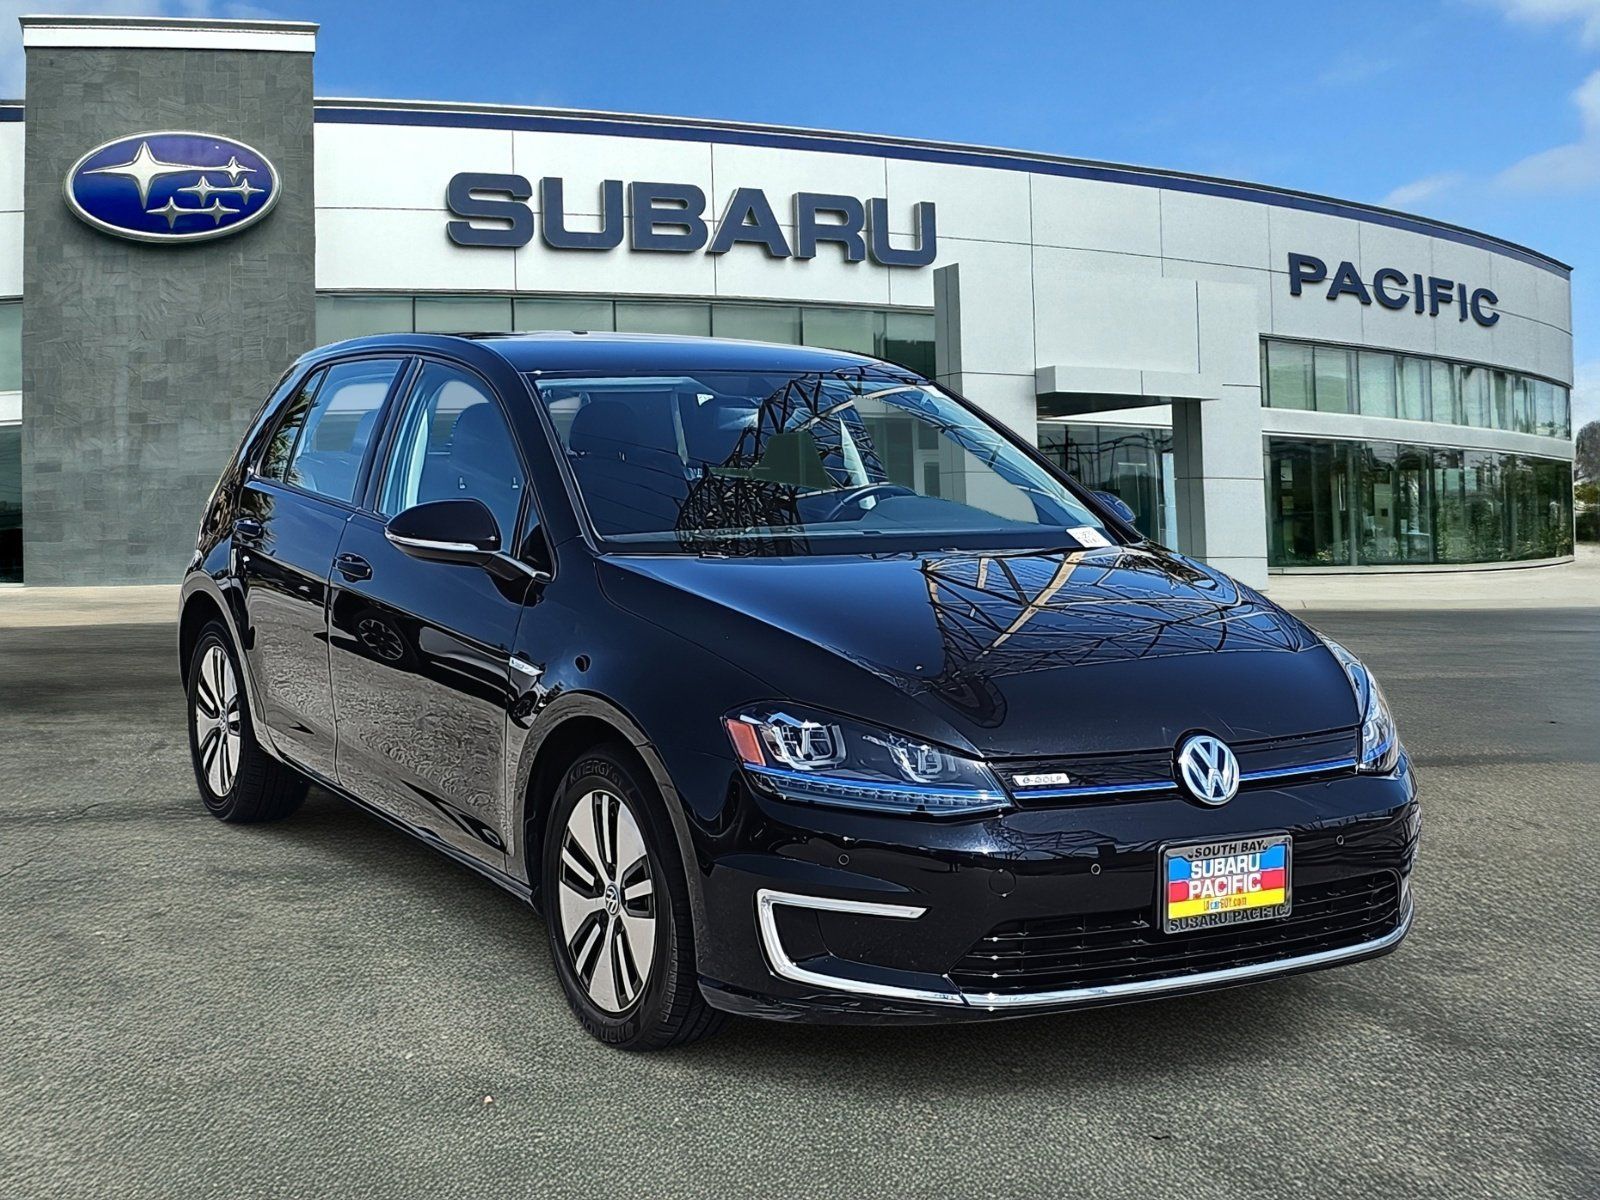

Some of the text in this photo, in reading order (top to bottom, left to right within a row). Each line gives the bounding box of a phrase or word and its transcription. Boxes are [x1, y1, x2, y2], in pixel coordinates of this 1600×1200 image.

[446, 171, 937, 267] SUBARU
[1287, 252, 1500, 327] PACIFIC
[1194, 840, 1265, 858] SOUTH BAY
[1190, 853, 1261, 879] SUBARU
[1188, 872, 1262, 900] PACIFIC
[1170, 904, 1287, 931] SUBARU PACIFIC
